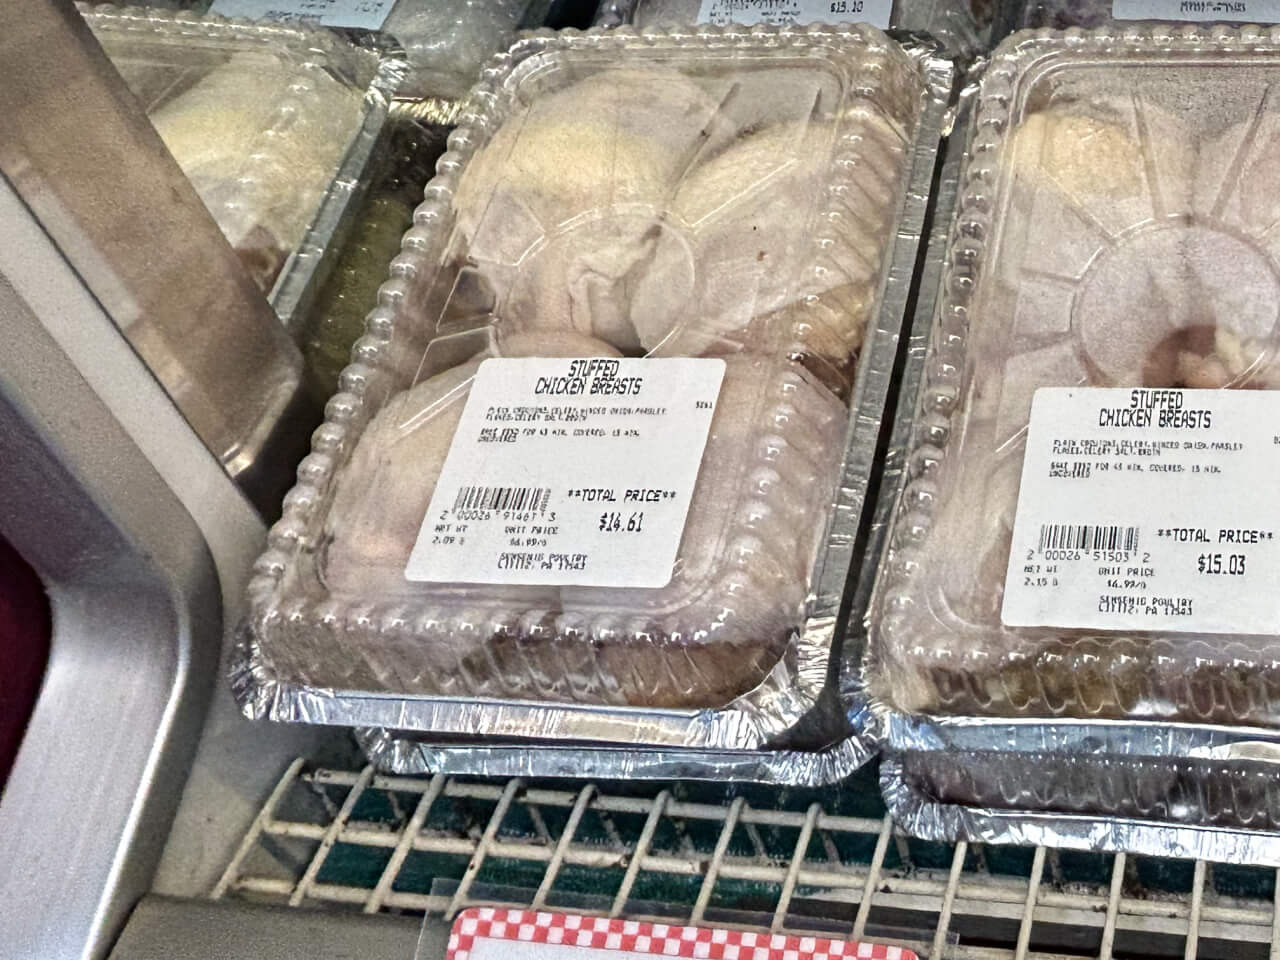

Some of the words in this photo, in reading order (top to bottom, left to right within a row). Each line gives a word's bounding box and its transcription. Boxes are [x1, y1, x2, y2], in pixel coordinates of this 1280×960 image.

[568, 359, 620, 377] STUFFED
[534, 377, 587, 394] CHICKEN
[590, 377, 643, 396] BREASTS
[1130, 390, 1184, 409] STUFFED
[1099, 408, 1151, 427] CHICKEN
[1158, 409, 1212, 429] BREASTS
[439, 510, 448, 520] 2
[456, 510, 491, 521] 00026
[503, 511, 537, 522] 91461
[548, 512, 556, 522] 3
[599, 512, 643, 533] $14.61
[504, 526, 526, 534] UNIT
[531, 526, 559, 535] PRICE
[1026, 549, 1035, 560] 2
[1045, 550, 1081, 561] 00026
[1093, 551, 1129, 562] 51503
[1142, 552, 1151, 563] 2
[1197, 553, 1246, 575] $15.03
[1023, 565, 1040, 573] NET
[1098, 567, 1121, 576] UNIT
[1127, 568, 1156, 577] PRICE
[1024, 577, 1047, 587] 2.15
[1145, 606, 1158, 615] PA
